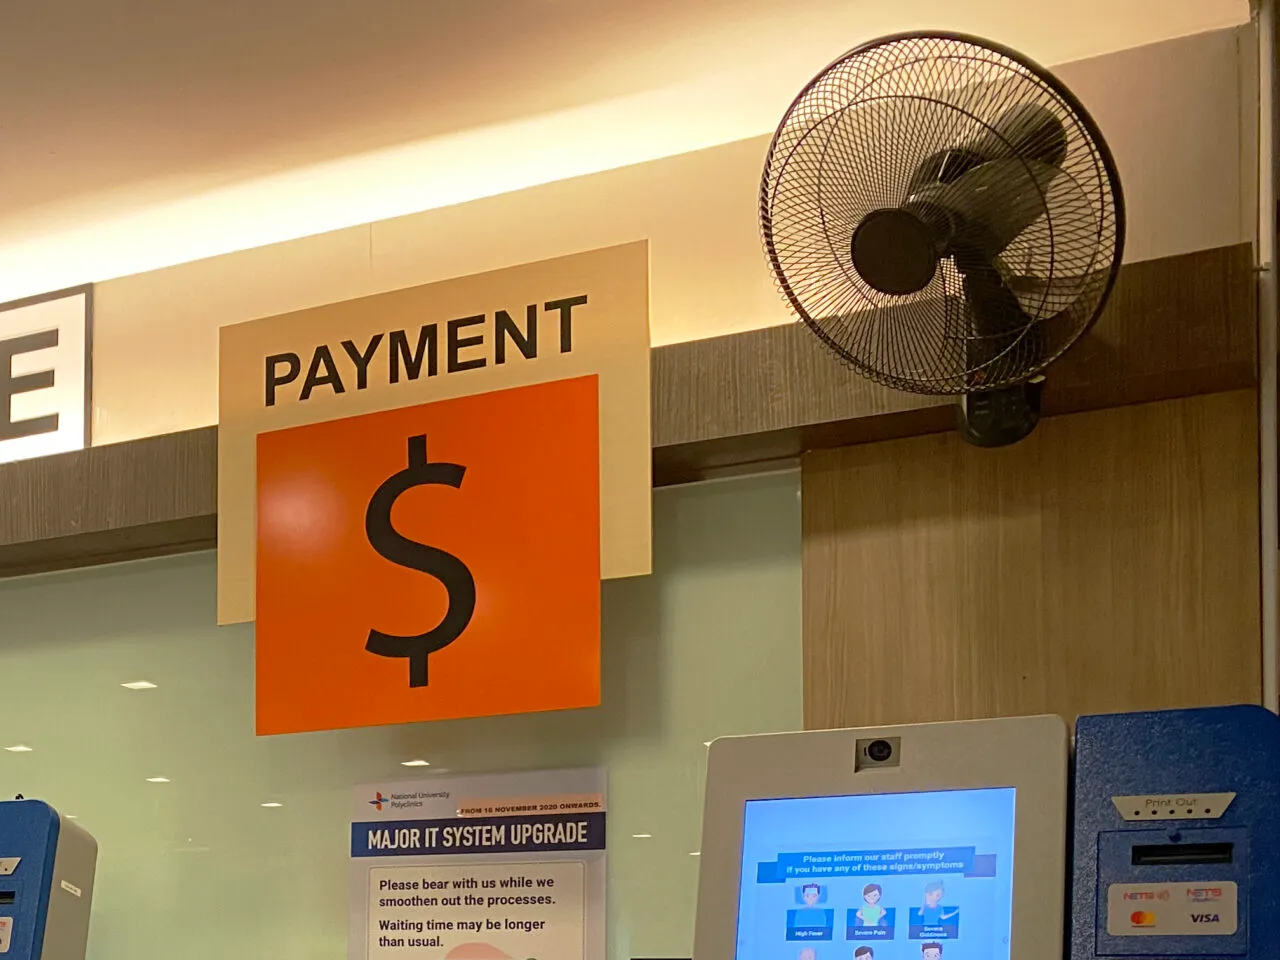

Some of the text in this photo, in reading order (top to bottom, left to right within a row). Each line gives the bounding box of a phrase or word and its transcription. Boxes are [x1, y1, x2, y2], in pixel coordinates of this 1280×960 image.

[265, 295, 588, 407] PAYMENT
[365, 433, 477, 688] $
[418, 791, 450, 799] University
[391, 801, 423, 809] Polyclinics
[495, 805, 538, 813] NOVEMBER
[1145, 798, 1197, 807] Print Out
[368, 821, 588, 850] MAJOR IT SYSTEM UPGRADE
[803, 851, 945, 864] Please inform our staff promptly
[795, 867, 810, 875] you
[812, 865, 833, 873] have
[834, 866, 850, 874] any
[852, 864, 862, 872] of
[863, 863, 888, 872] these
[889, 861, 964, 872] signs/symptoms
[379, 877, 554, 891] Please bear with us while we
[1123, 888, 1223, 900] NETS NETS
[379, 895, 556, 908] smoothen out the processes.
[1190, 913, 1220, 923] VISA
[379, 919, 546, 932] Waiting time may be longer
[379, 936, 444, 947] than usual.
